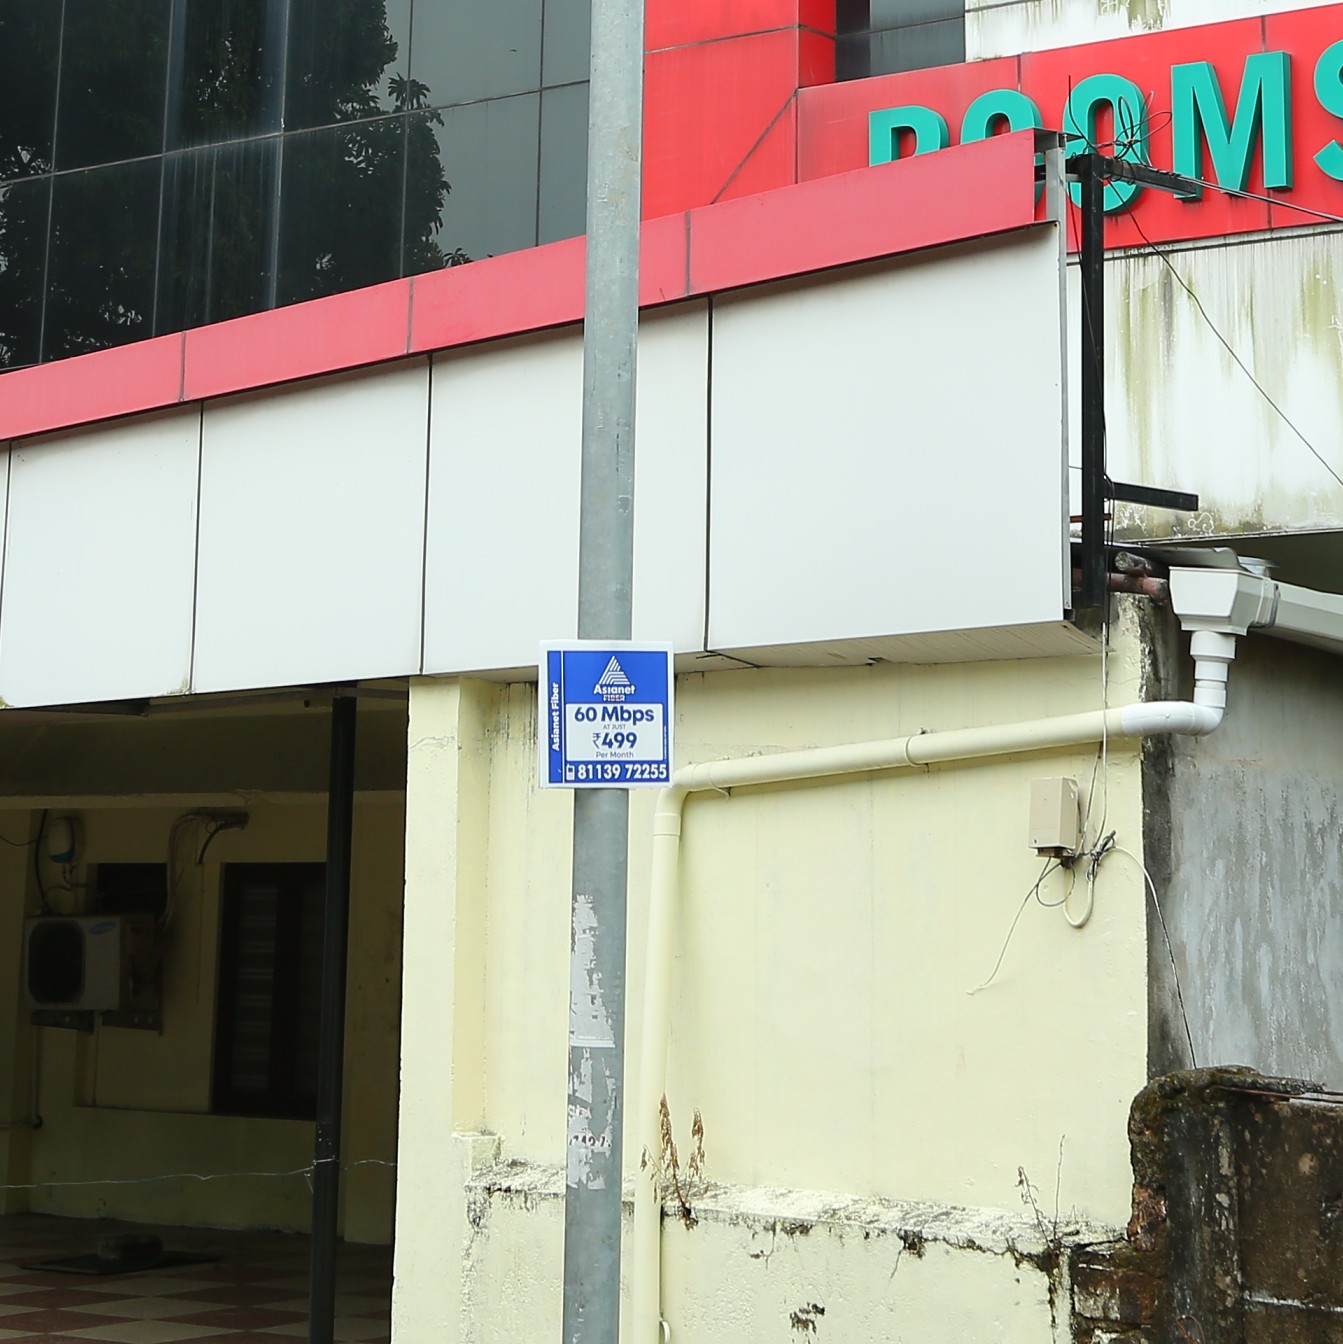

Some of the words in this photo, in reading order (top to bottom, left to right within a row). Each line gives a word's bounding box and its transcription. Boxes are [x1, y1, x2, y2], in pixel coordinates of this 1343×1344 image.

[551, 682, 560, 709] Fiber
[593, 684, 636, 695] Asianet
[574, 707, 597, 722] 60
[601, 706, 655, 726] Mbps
[551, 711, 560, 751] Asianet
[596, 751, 608, 759] Per
[610, 751, 634, 759] Month
[578, 764, 621, 779] 81139
[625, 763, 667, 779] 72255
